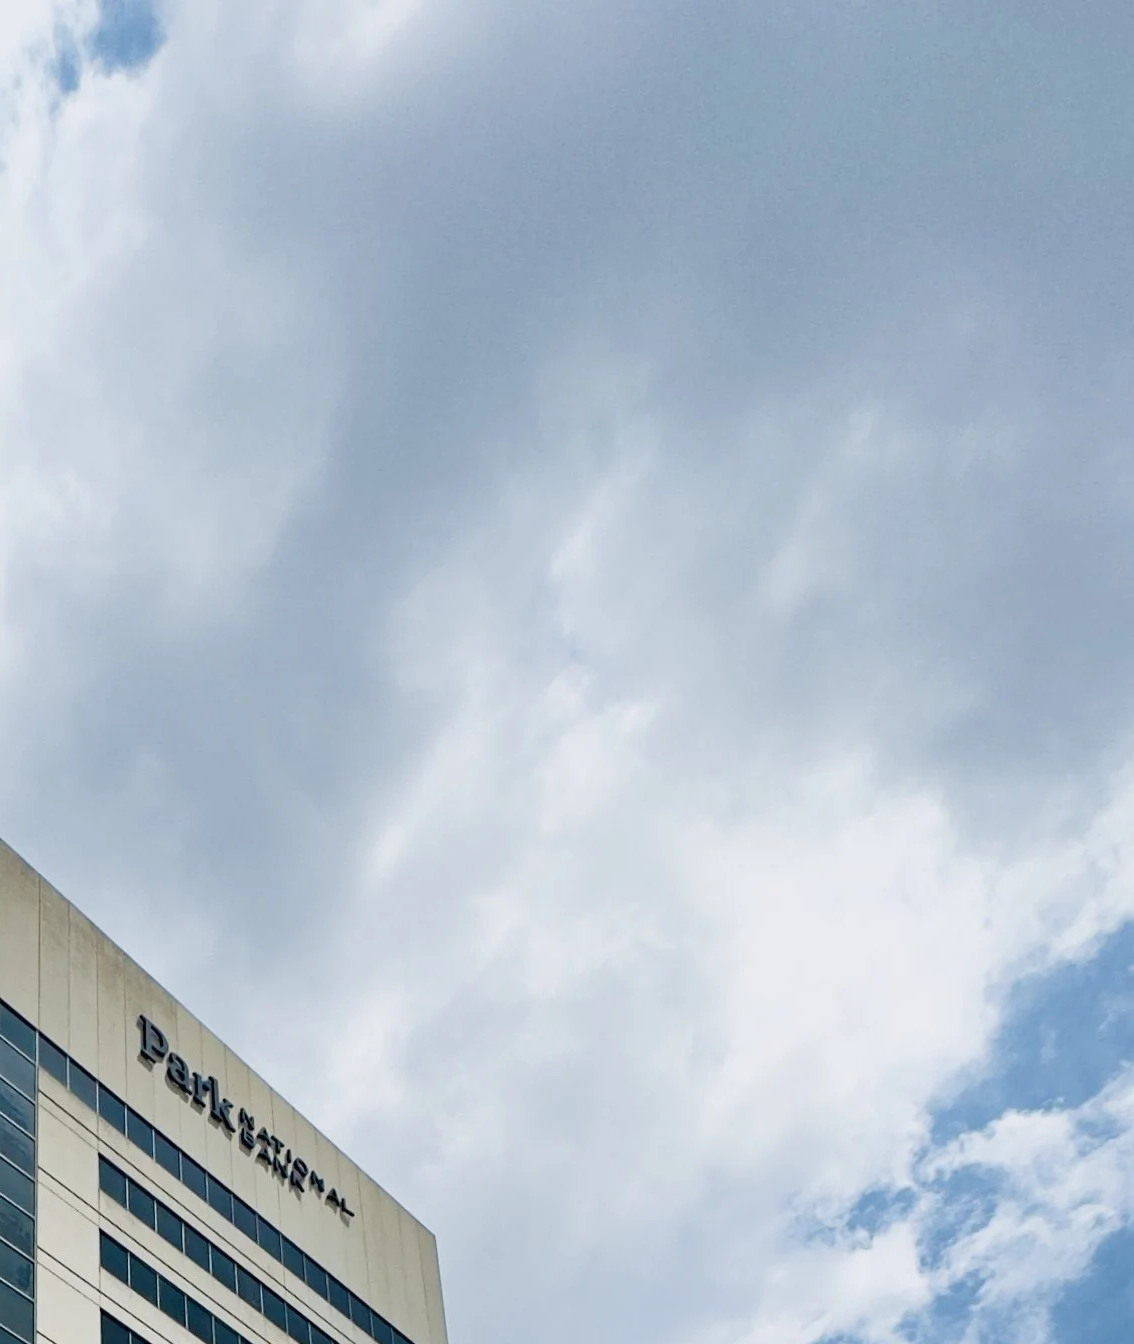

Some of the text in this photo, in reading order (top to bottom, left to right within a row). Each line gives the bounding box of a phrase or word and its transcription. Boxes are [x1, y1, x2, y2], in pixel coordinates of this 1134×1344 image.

[137, 1014, 236, 1133] Park
[238, 1107, 355, 1218] NATIONAL
[239, 1127, 305, 1193] BANK
